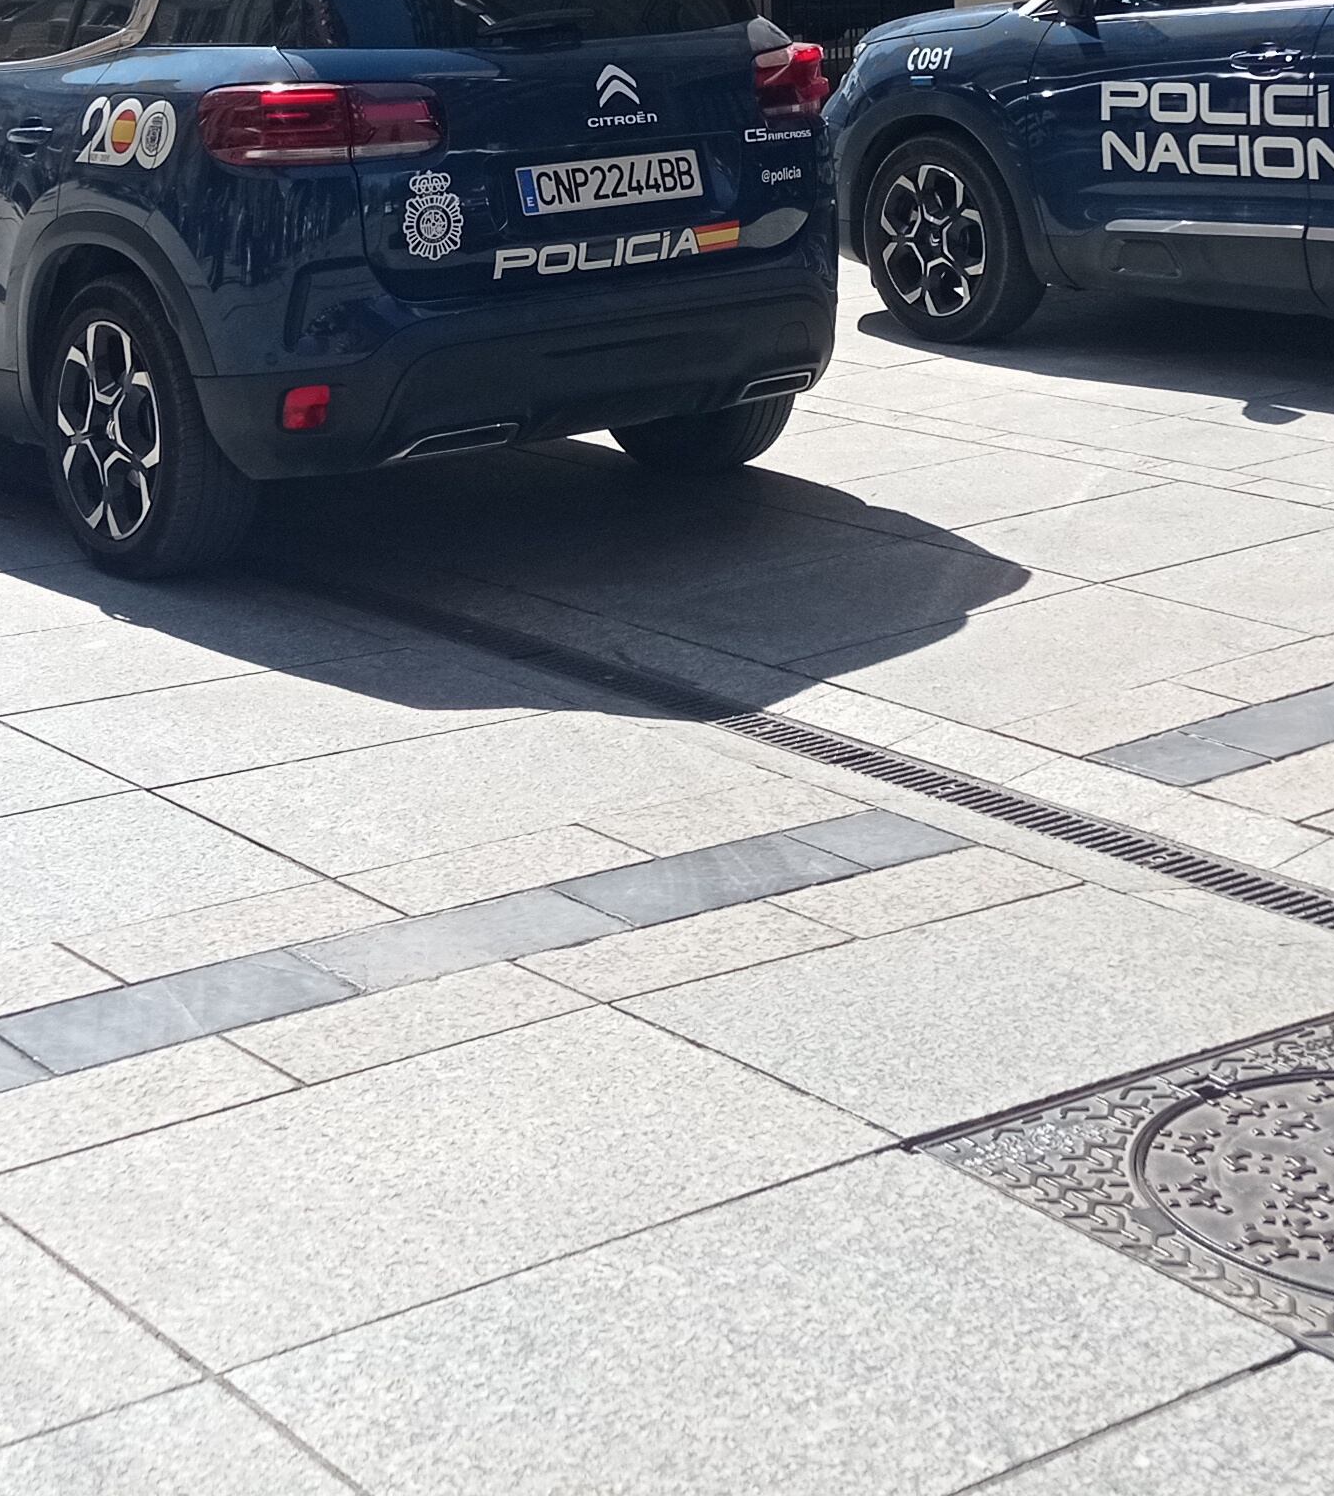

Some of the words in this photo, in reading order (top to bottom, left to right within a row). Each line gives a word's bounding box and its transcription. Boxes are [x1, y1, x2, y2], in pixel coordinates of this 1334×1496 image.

[916, 47, 953, 71] 091
[587, 111, 658, 128] CITROËN
[75, 95, 177, 170] 200
[744, 127, 767, 143] C5
[767, 128, 812, 141] AIRCROSS
[536, 156, 696, 206] CNP2244BB
[761, 165, 803, 184] @policia
